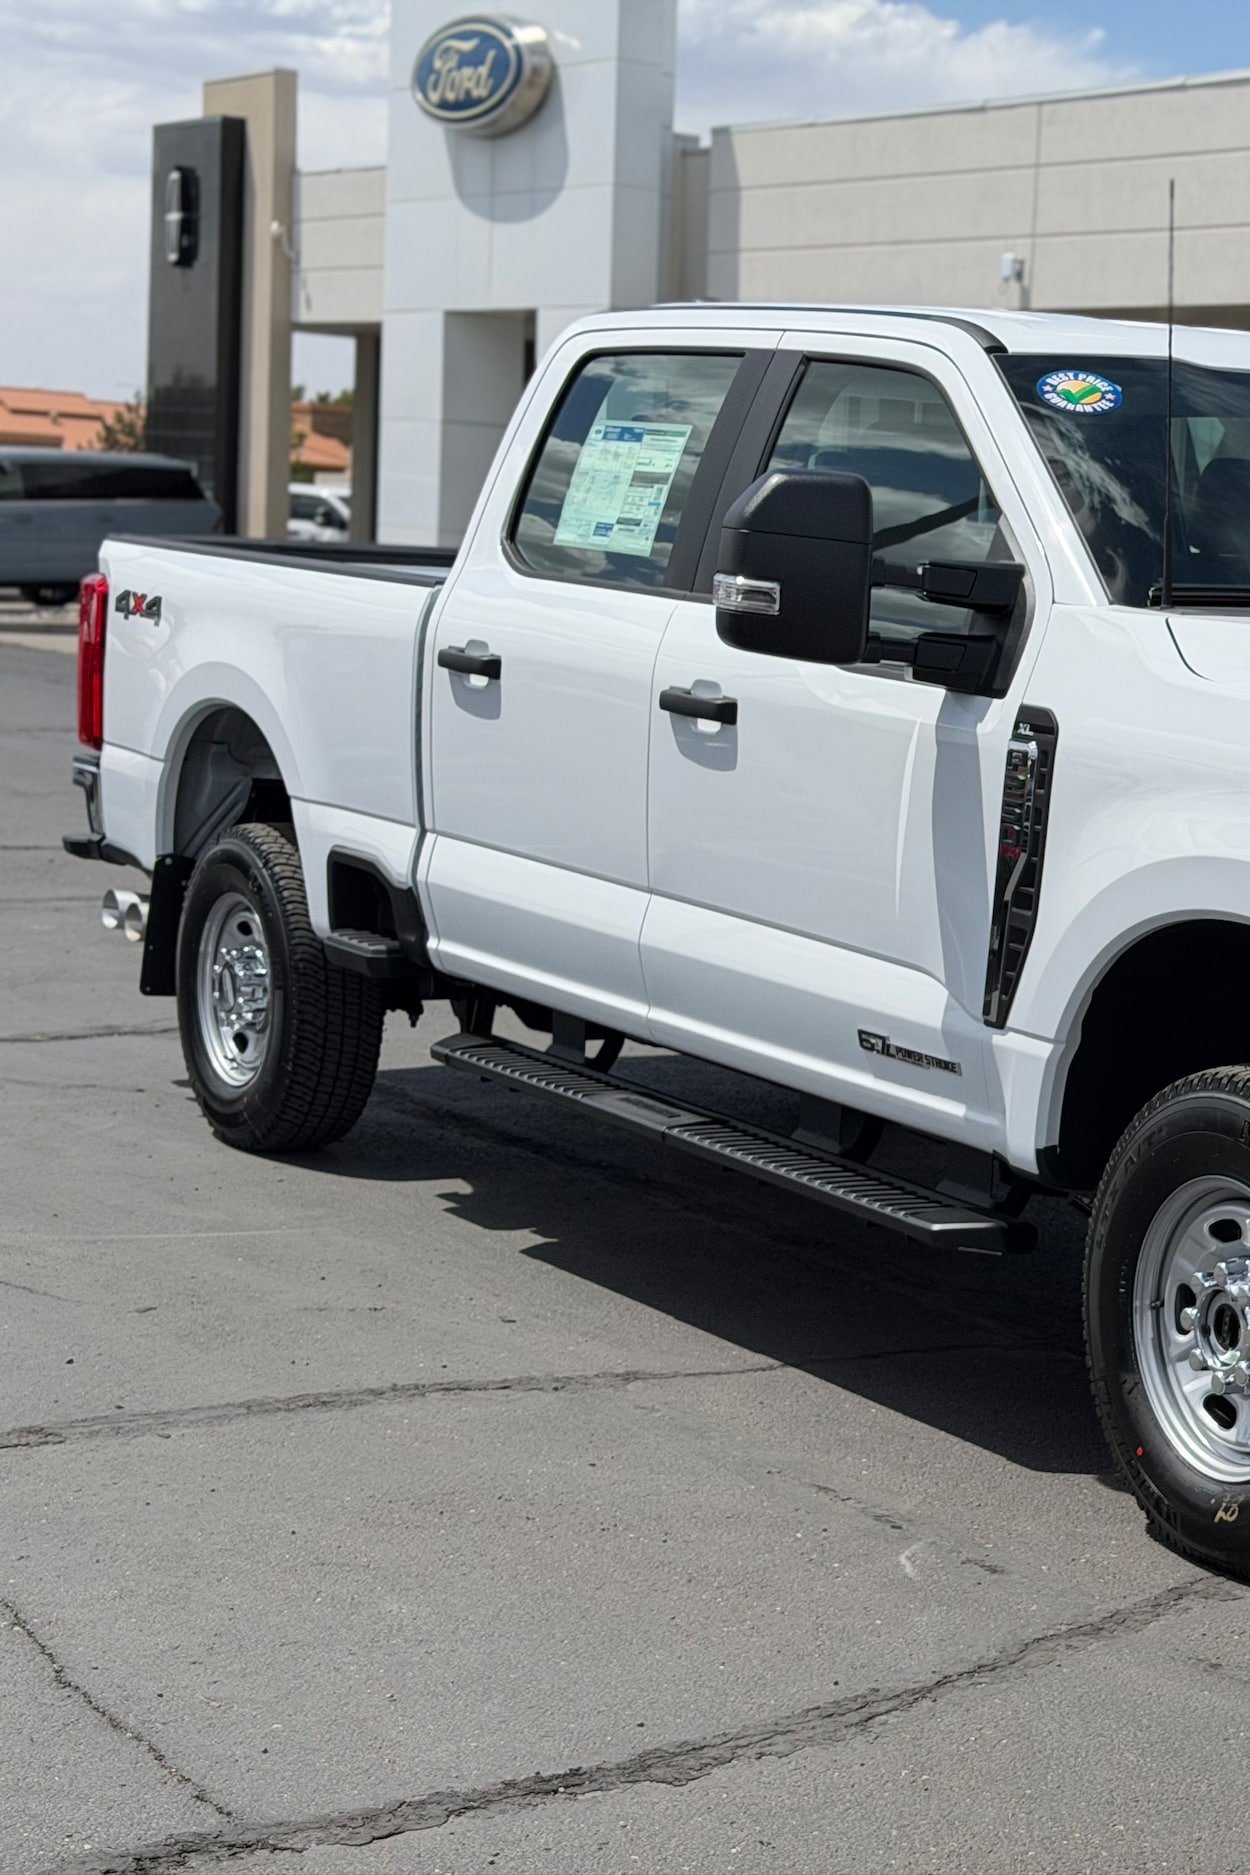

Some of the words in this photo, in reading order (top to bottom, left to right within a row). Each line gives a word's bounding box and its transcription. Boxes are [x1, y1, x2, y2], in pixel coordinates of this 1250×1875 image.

[427, 38, 497, 105] Ford
[1078, 373, 1114, 392] PRICE
[1043, 392, 1115, 413] GUARANTEE
[1017, 722, 1035, 737] XL
